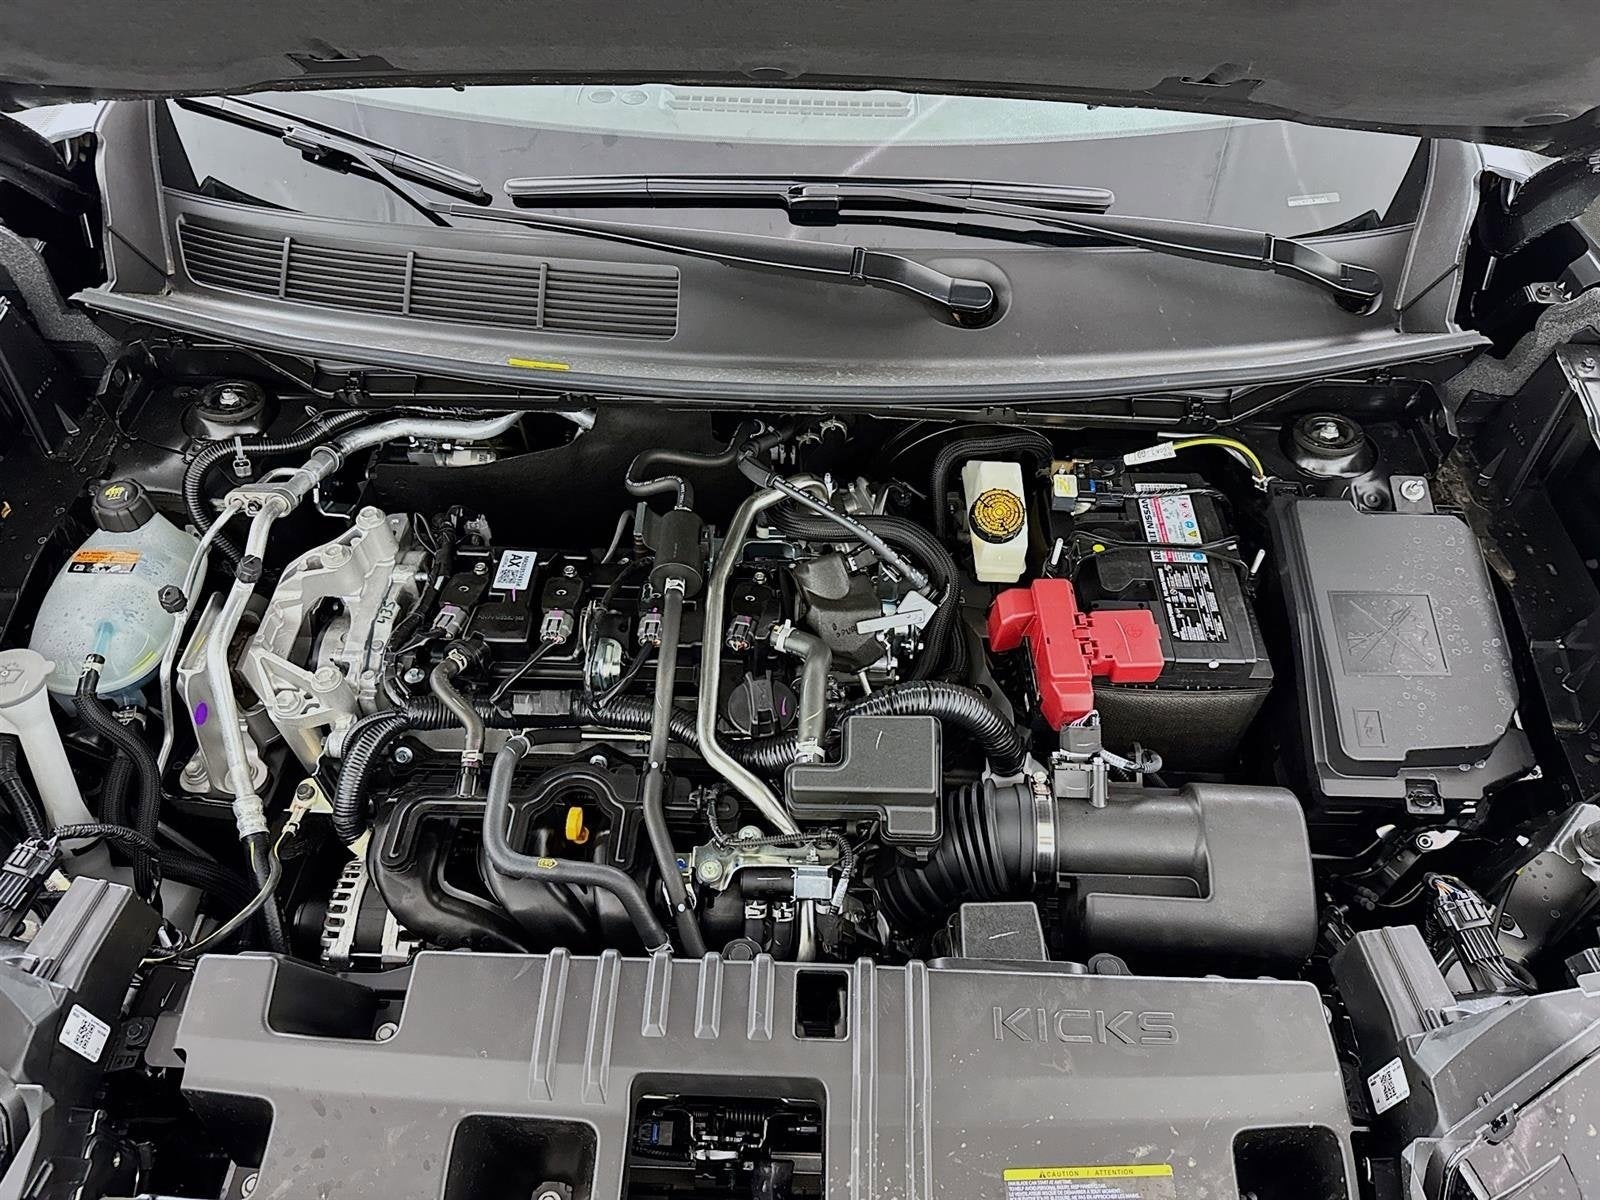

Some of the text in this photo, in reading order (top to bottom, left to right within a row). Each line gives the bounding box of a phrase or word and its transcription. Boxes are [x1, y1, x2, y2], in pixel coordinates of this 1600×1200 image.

[1141, 497, 1155, 529] NISSAN
[508, 554, 523, 568] AX
[992, 1006, 1179, 1046] KICKS
[1094, 1168, 1134, 1176] ATTENTION
